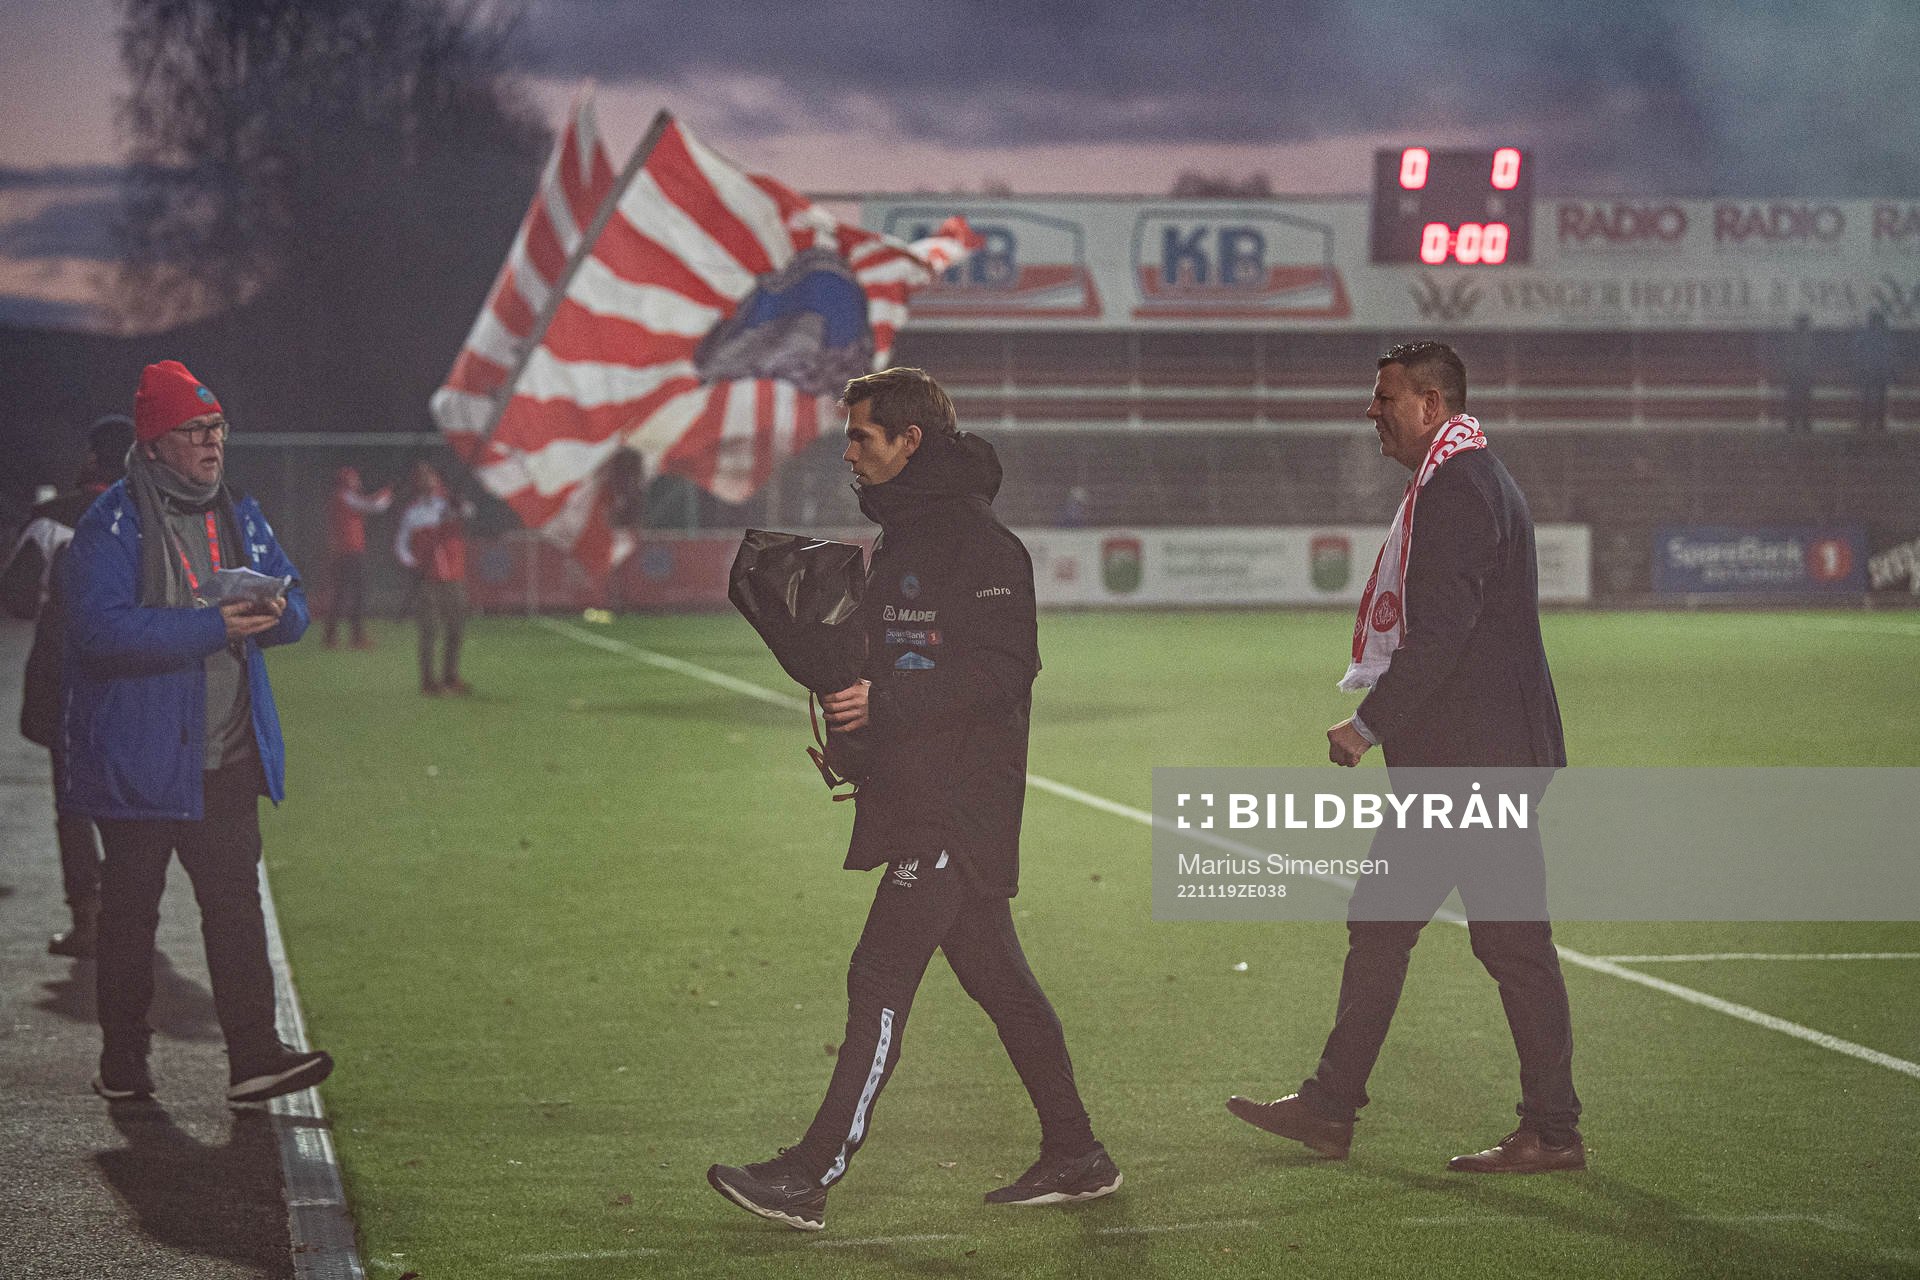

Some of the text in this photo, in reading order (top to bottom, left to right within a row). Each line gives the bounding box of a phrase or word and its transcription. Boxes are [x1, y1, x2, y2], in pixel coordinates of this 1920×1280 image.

[1400, 147, 1430, 190] 0
[1490, 147, 1522, 190] 0
[1556, 206, 1688, 241] RADIO
[1713, 206, 1846, 241] RADIO
[1162, 226, 1266, 285] KB
[1420, 222, 1510, 265] 0:00
[1822, 544, 1838, 575] 1
[976, 587, 1011, 598] umbro
[898, 609, 936, 622] MAPEI
